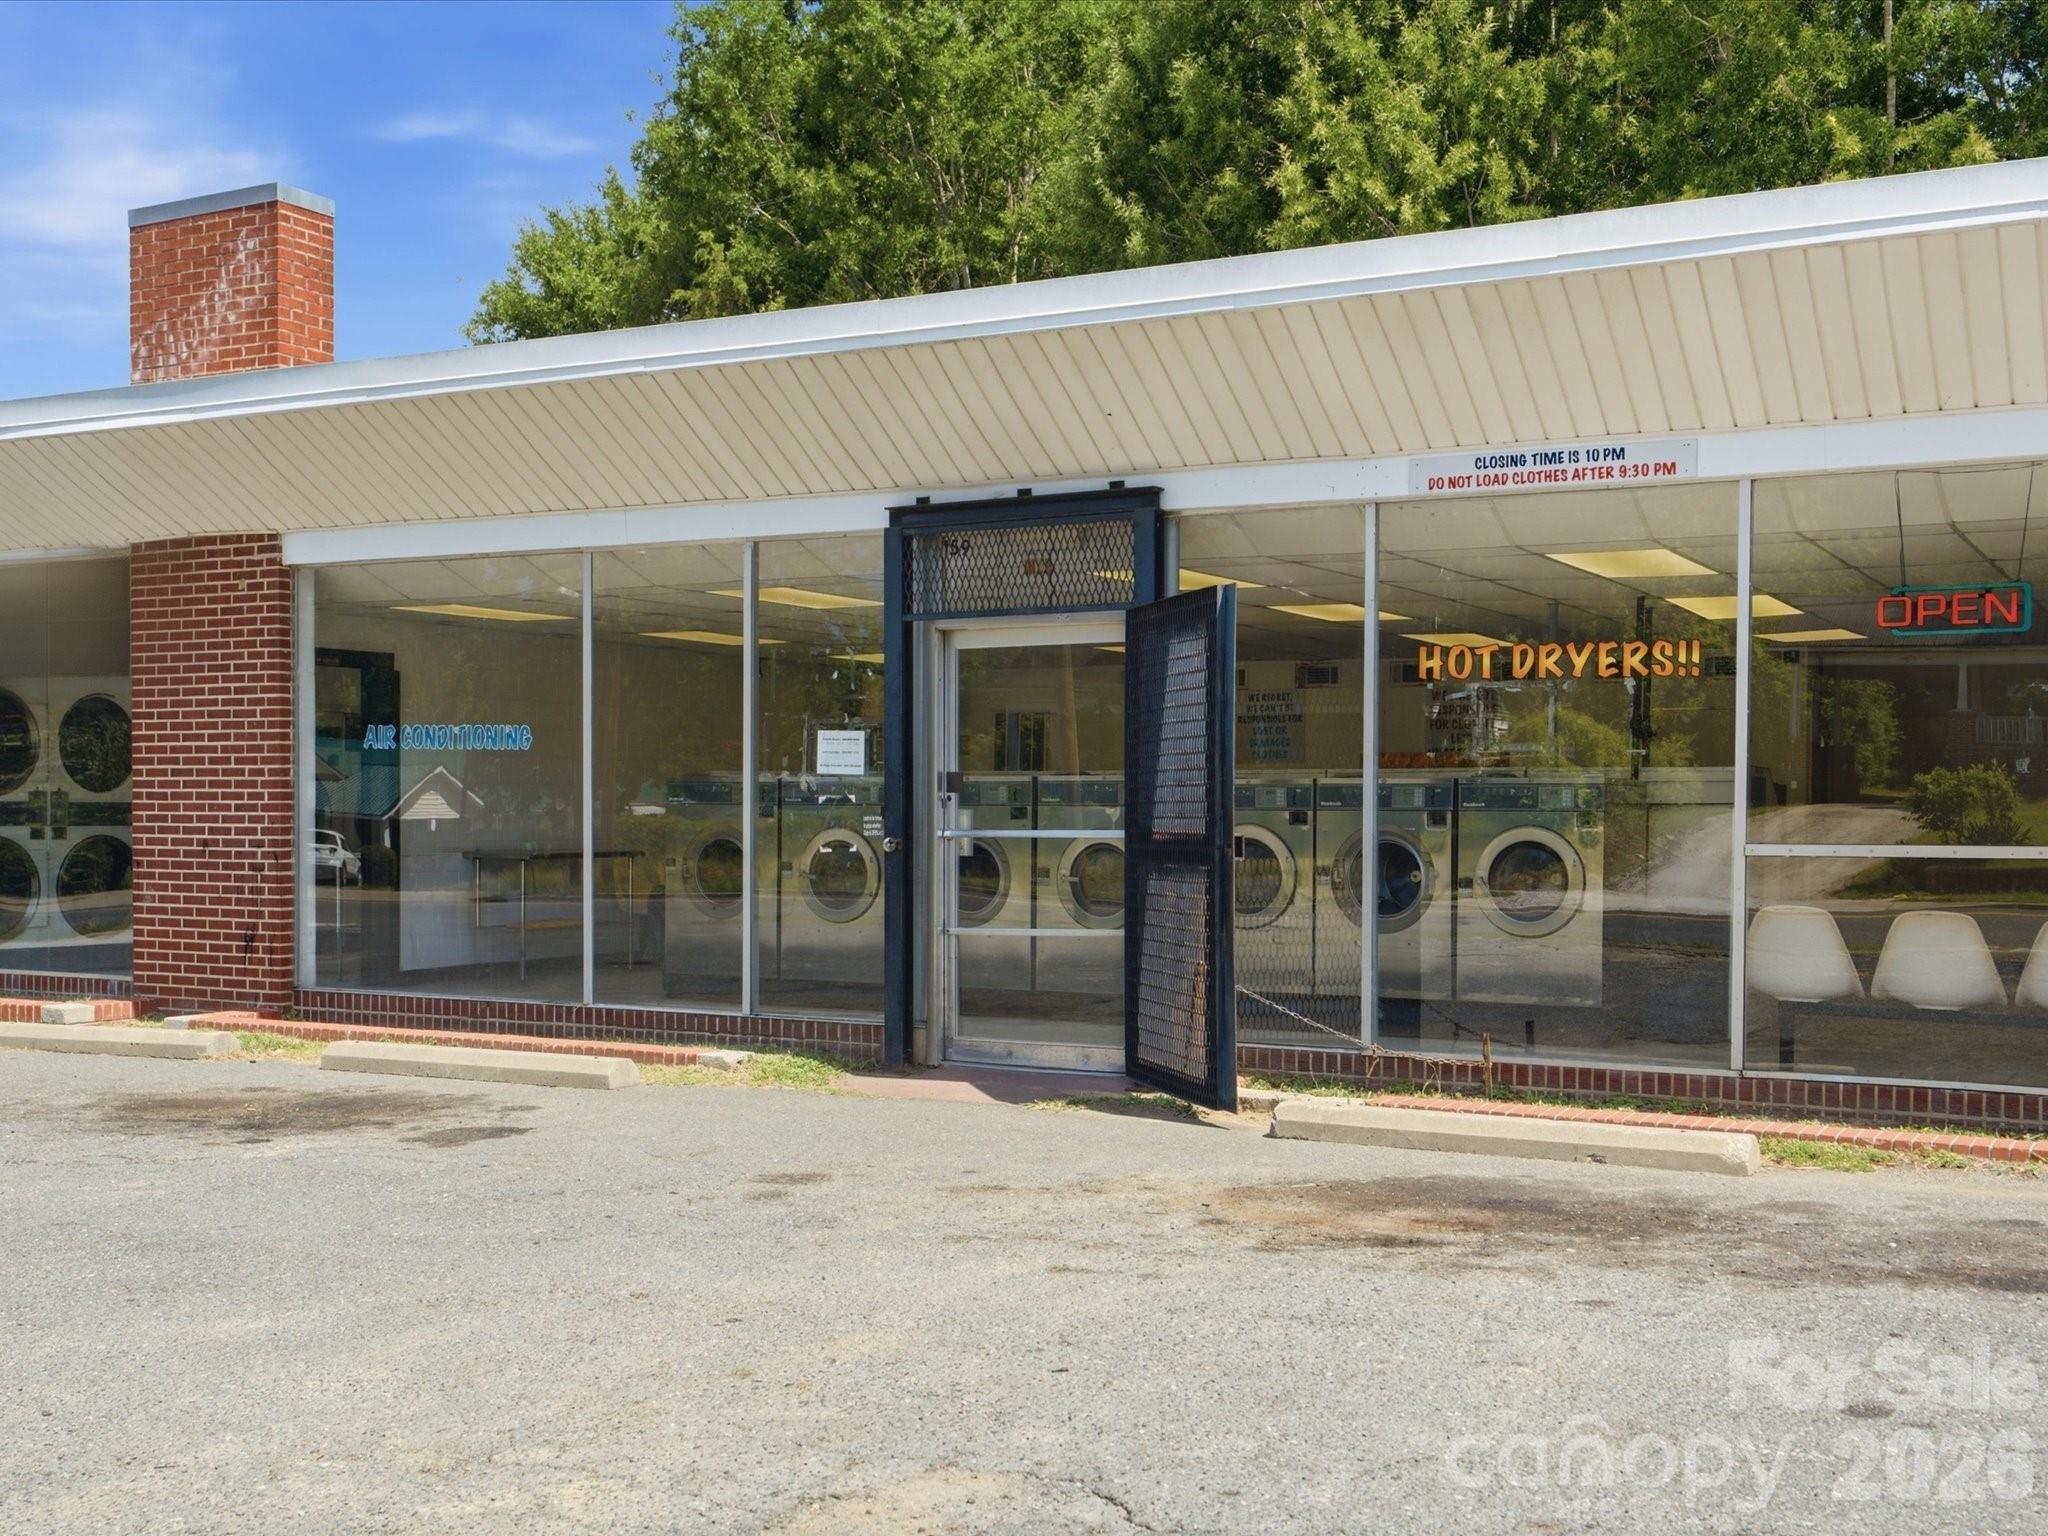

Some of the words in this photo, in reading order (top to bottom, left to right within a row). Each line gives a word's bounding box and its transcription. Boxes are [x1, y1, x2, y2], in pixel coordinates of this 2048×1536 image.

[1474, 452, 1528, 471] CLOSING
[1531, 449, 1565, 467] TIME
[1568, 449, 1580, 464] IS
[1586, 448, 1600, 463] 10
[1603, 447, 1626, 462] PM
[1428, 476, 1445, 491] DO
[1448, 474, 1473, 490] NOT
[1476, 472, 1509, 488] LOAD
[1512, 467, 1568, 486] CLOTHES
[1571, 464, 1615, 482] AFTER
[1618, 462, 1650, 479] 9:30
[1654, 461, 1677, 477] PM
[1876, 590, 2018, 628] OPEN
[1418, 643, 1499, 680] HOT
[1511, 639, 1701, 680] DRYERS!!
[364, 724, 397, 750] AIR
[400, 724, 533, 751] CONDITIONING
